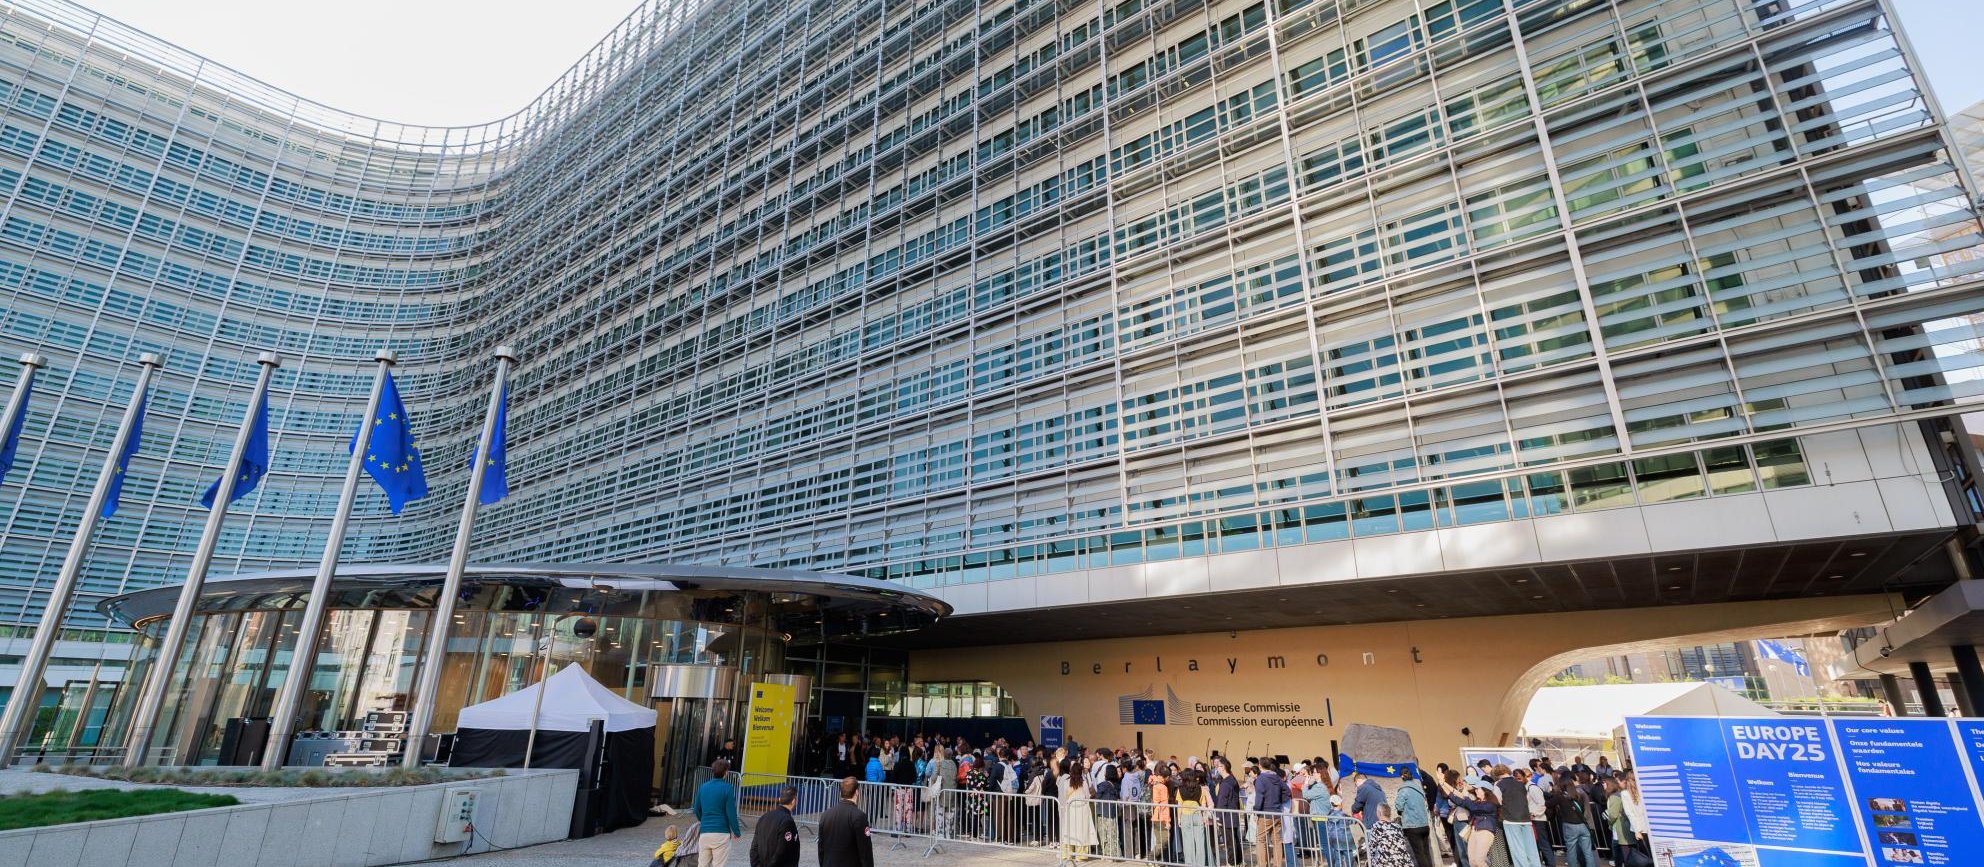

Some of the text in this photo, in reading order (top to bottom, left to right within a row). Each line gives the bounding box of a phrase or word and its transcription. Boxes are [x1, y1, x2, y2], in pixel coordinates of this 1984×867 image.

[1060, 646, 1423, 676] Berlaymont
[1195, 702, 1301, 715] Europese Commissie
[1196, 715, 1325, 728] Commission européenne
[1731, 725, 1821, 742] EUROPE
[1869, 740, 1924, 748] fundamentele
[1735, 742, 1826, 762] DAY25
[1787, 771, 1825, 779] Bienvenue
[1857, 767, 1916, 775] fondamentales
